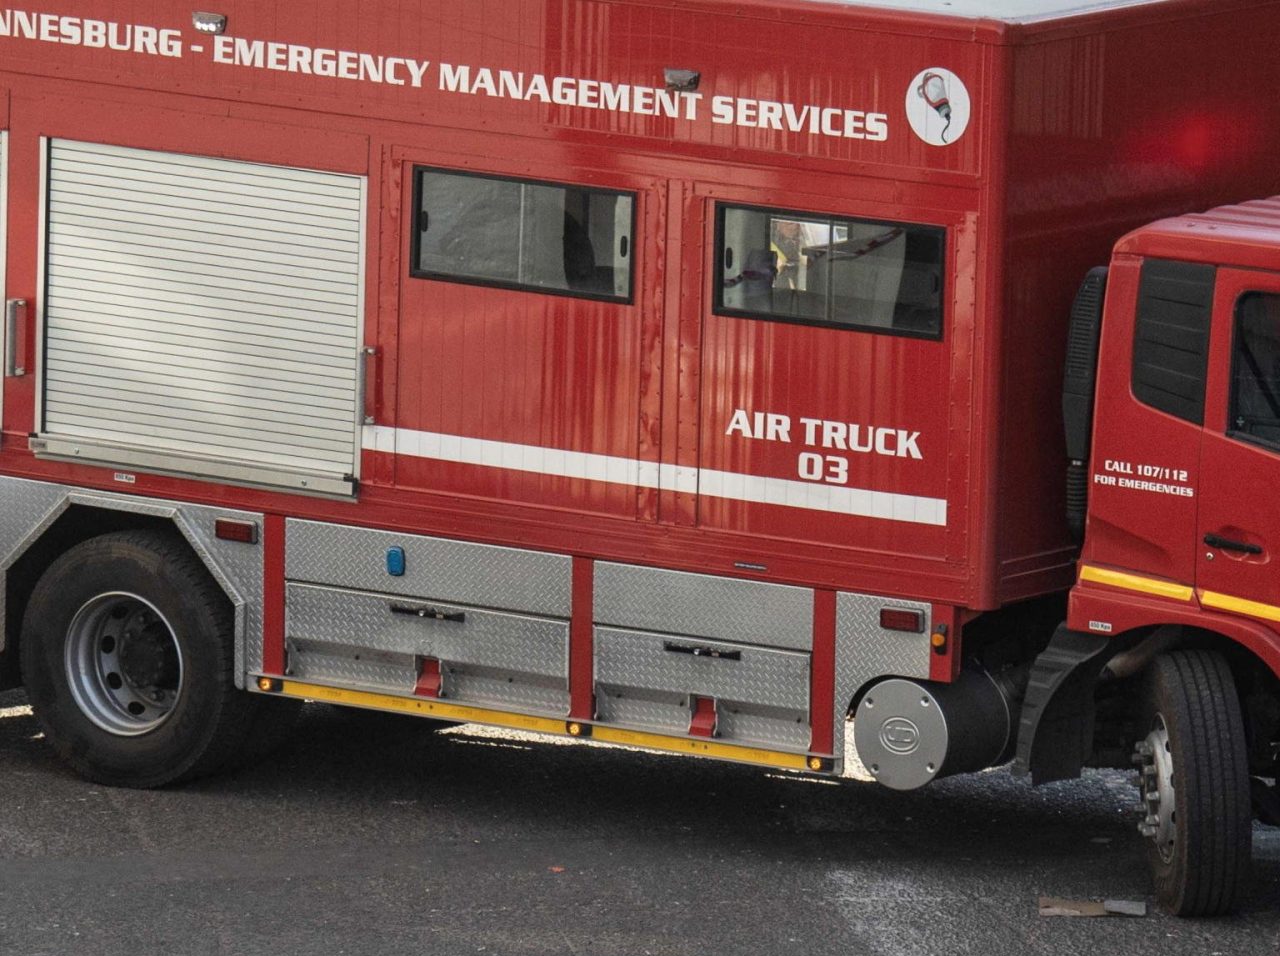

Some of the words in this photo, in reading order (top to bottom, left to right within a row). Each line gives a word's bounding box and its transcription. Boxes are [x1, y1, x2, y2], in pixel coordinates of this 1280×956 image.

[190, 45, 204, 53] -
[213, 35, 430, 88] EMERGENCY
[439, 63, 703, 121] MANAGEMENT
[711, 95, 888, 142] SERVICES
[725, 409, 791, 443] AIR
[799, 417, 923, 460] TRUCK
[798, 452, 849, 485] 03
[1104, 459, 1133, 474] CALL
[1137, 464, 1188, 481] 107/112
[1094, 474, 1116, 486] FOR
[1118, 478, 1194, 497] EMERGENCIES
